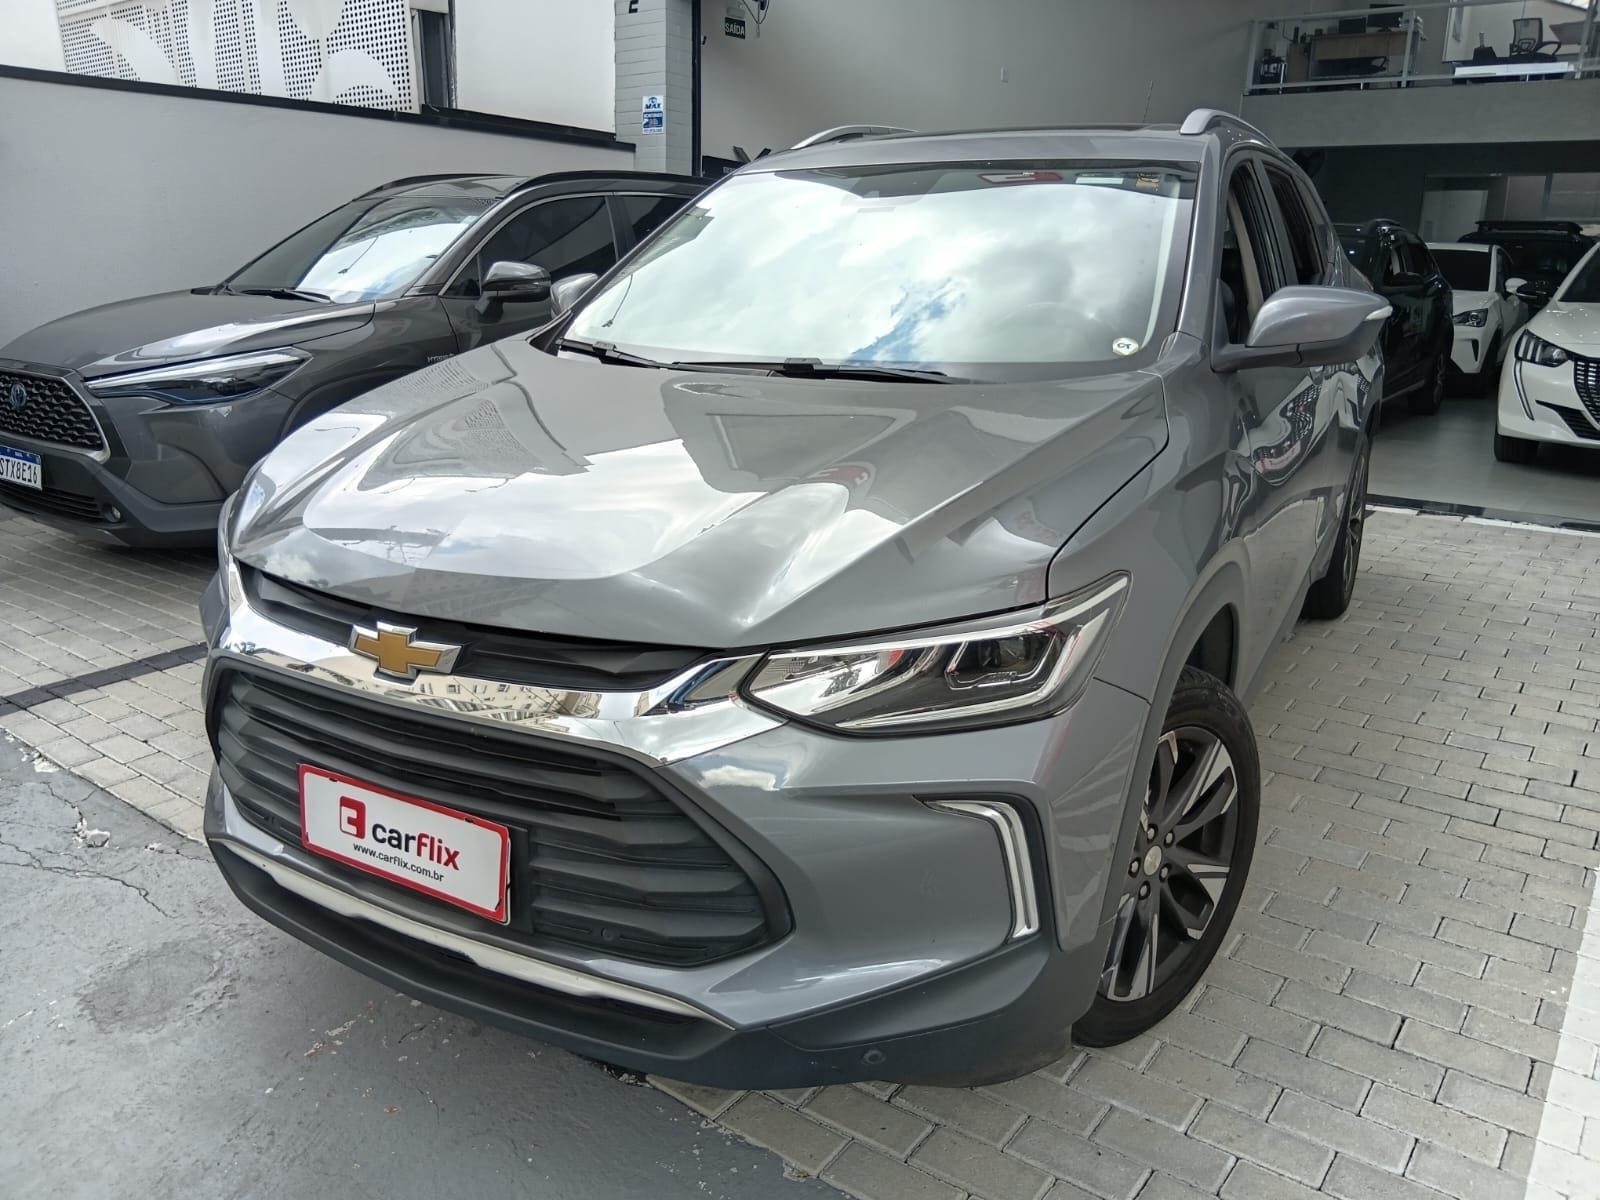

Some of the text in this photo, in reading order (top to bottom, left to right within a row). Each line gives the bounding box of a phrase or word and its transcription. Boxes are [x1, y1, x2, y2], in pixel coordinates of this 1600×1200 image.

[725, 22, 745, 35] SAÍDA
[0, 457, 38, 484] STX8E16
[352, 843, 444, 882] www.carflix.com.br
[372, 822, 460, 870] carflix
